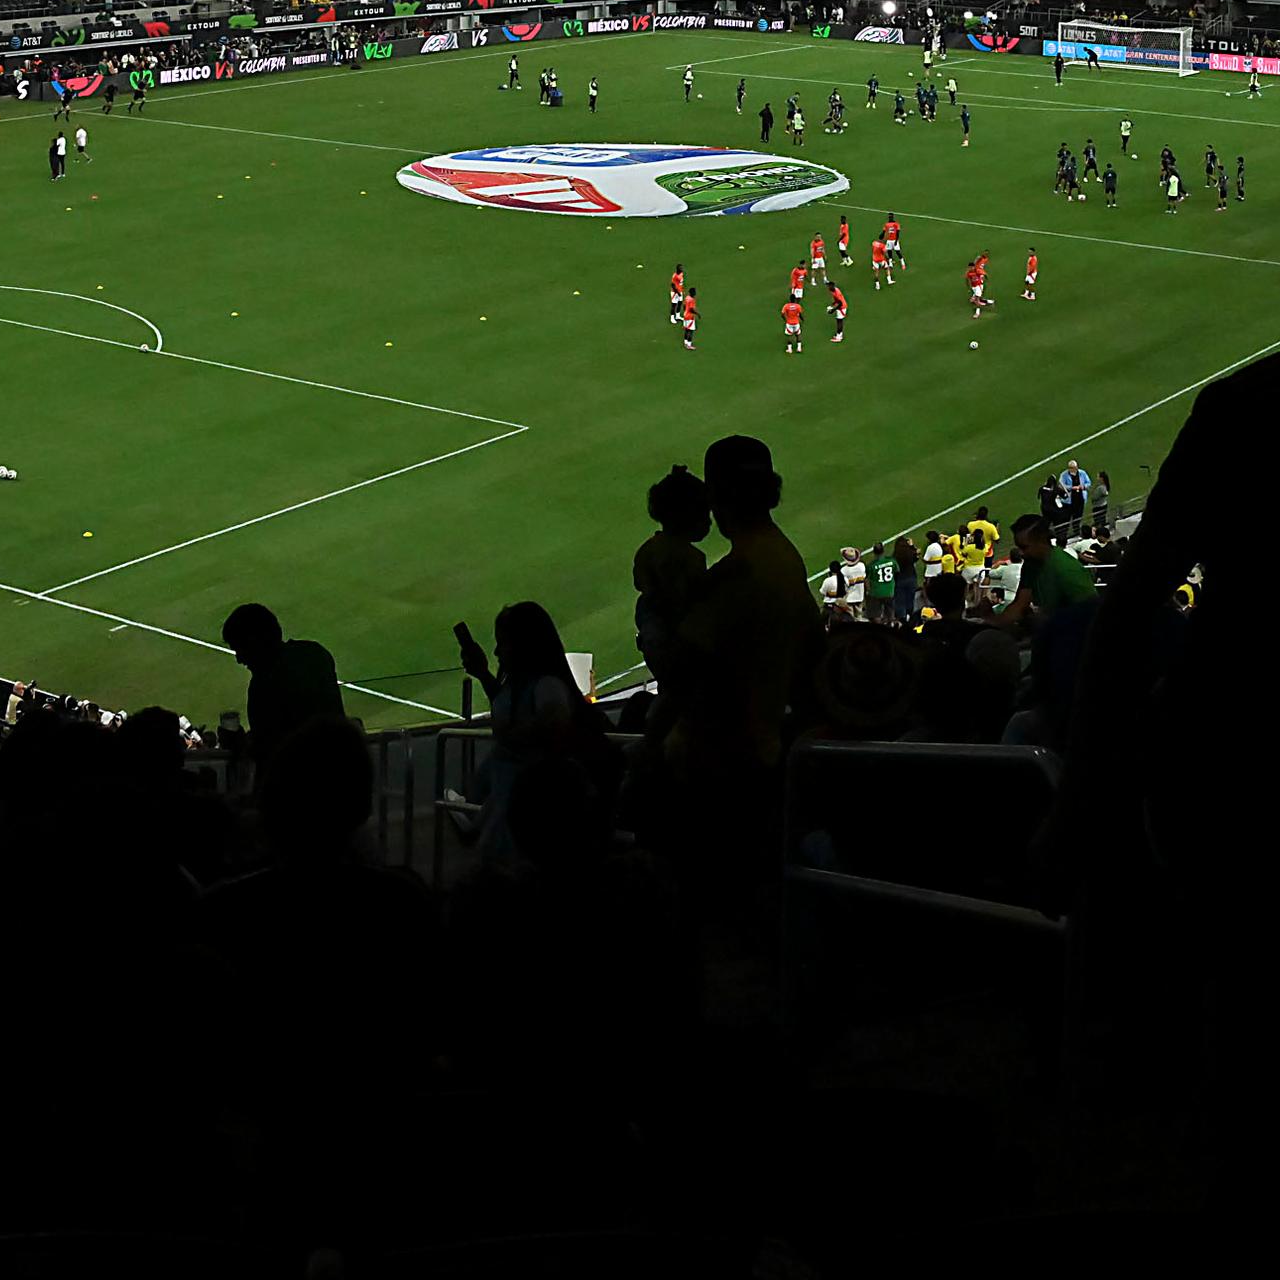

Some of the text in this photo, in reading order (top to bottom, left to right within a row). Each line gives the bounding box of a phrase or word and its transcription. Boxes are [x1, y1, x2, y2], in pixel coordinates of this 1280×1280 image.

[588, 16, 629, 33] MÉXICO
[631, 14, 651, 31] VS
[654, 15, 707, 29] COLOMBIA
[714, 18, 746, 28] PRESENTED
[746, 19, 754, 28] BY
[22, 35, 42, 47] AT&T
[471, 29, 489, 47] VS
[160, 65, 212, 84] MÉXICO
[238, 55, 287, 74] COLOMBIA
[292, 53, 320, 66] PRESENTED
[877, 567, 893, 582] 18
